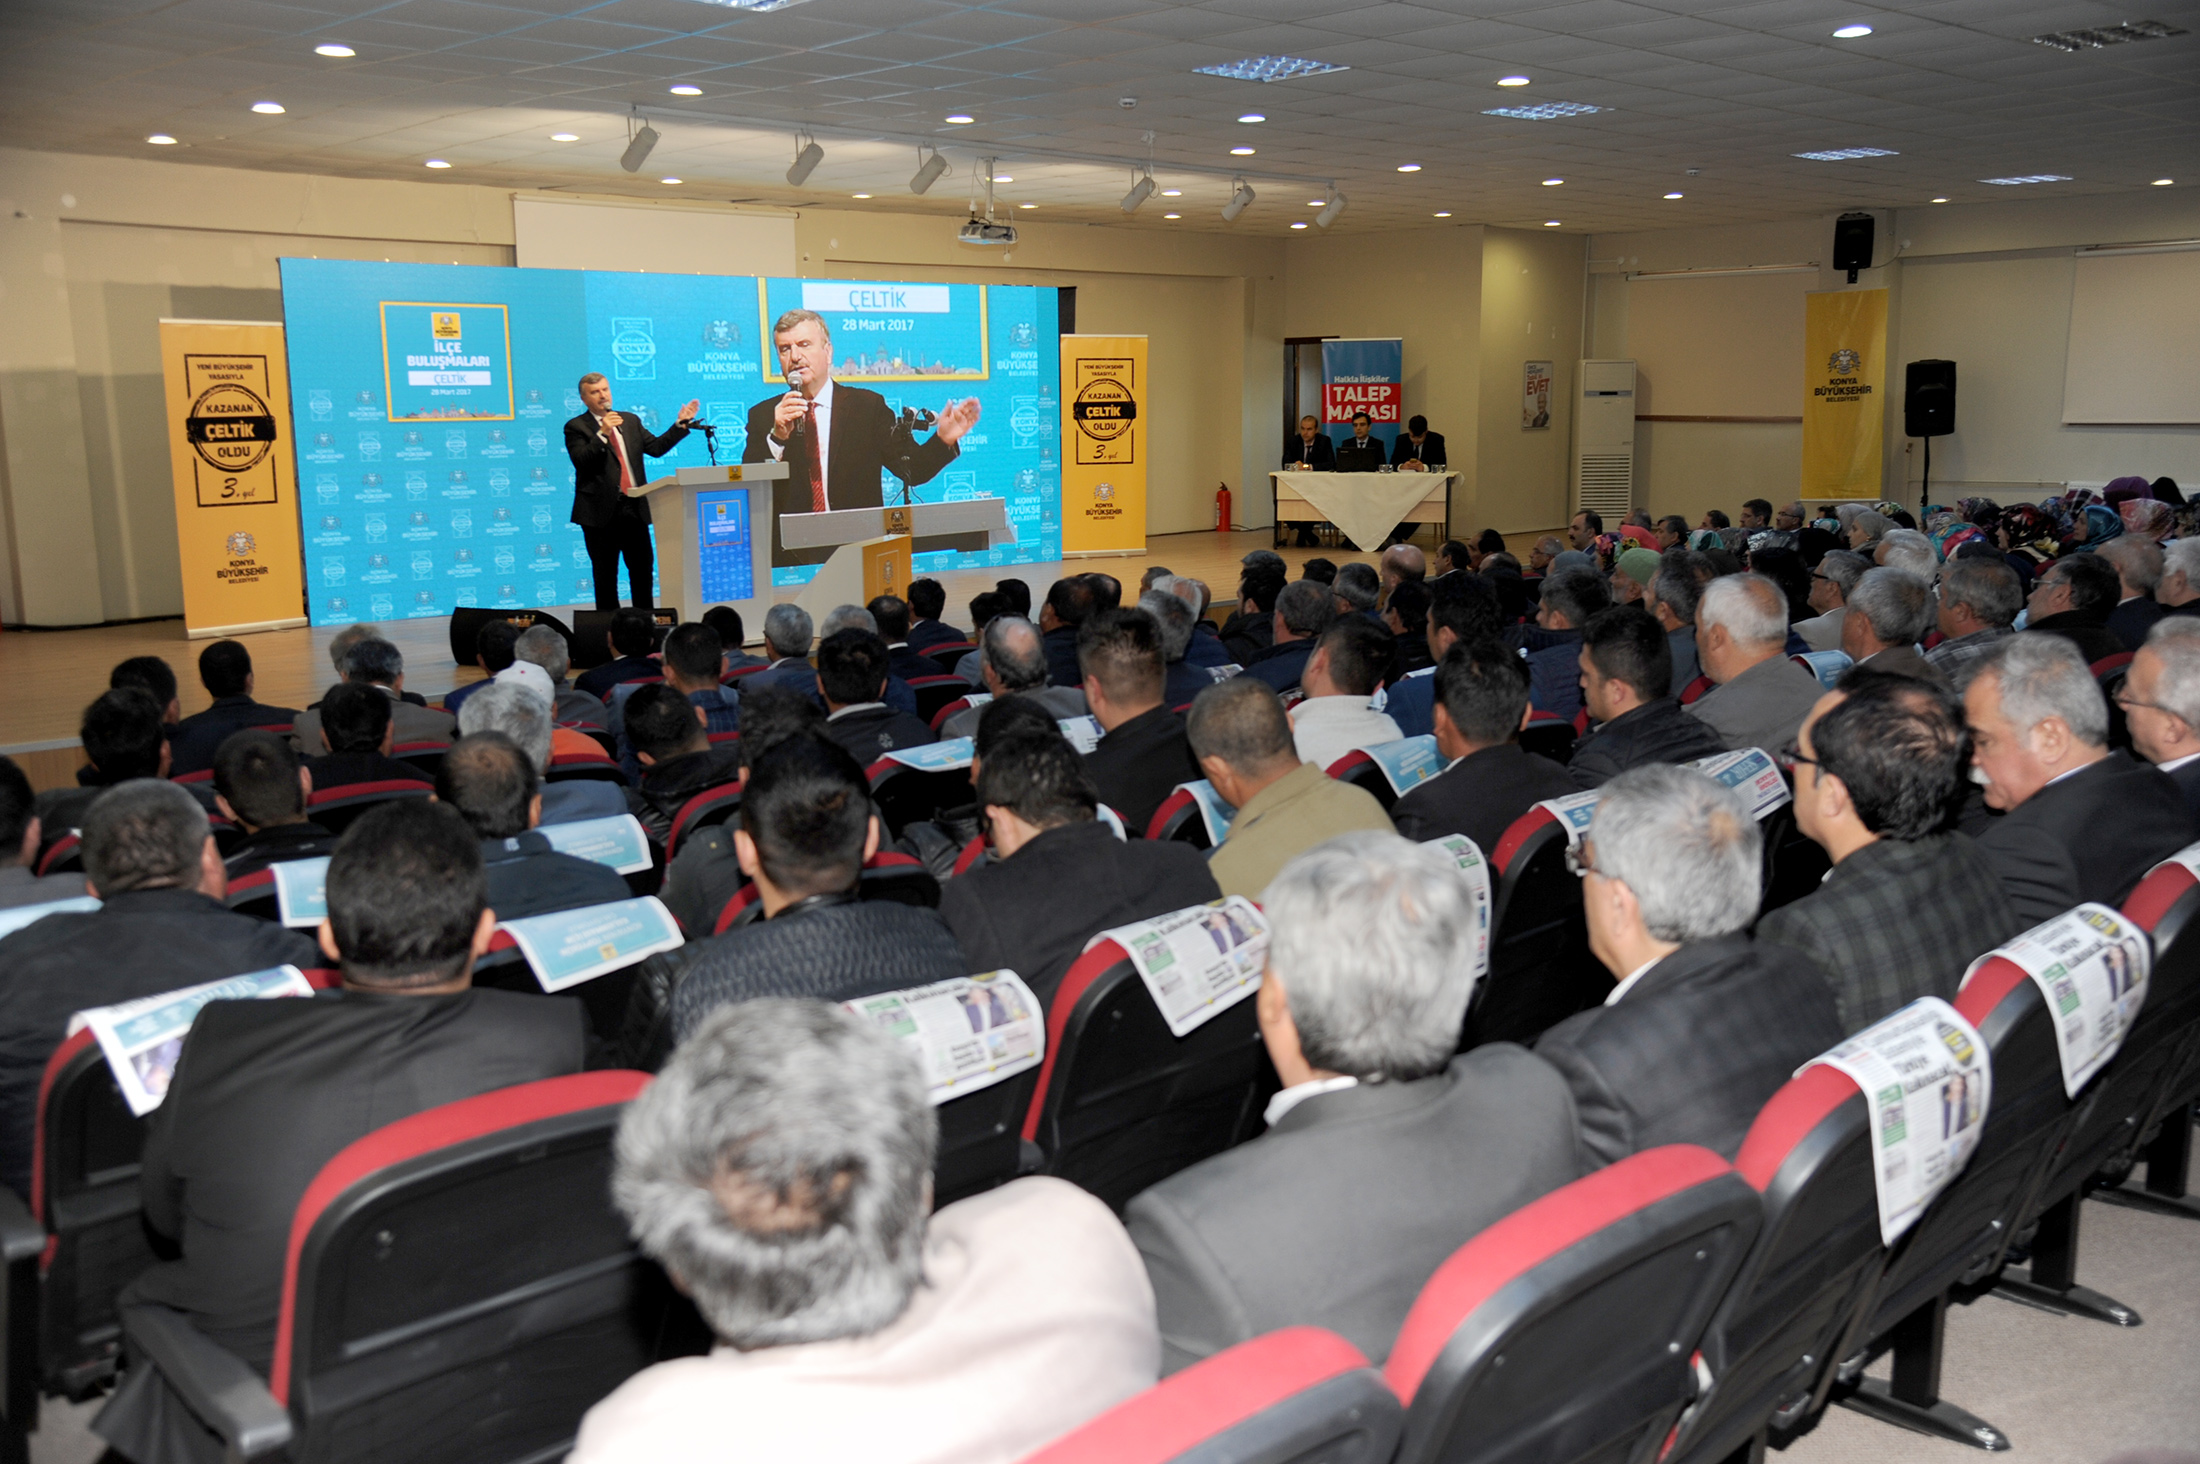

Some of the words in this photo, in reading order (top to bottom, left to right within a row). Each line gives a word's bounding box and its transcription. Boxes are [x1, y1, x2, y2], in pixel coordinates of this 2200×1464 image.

[849, 287, 907, 312] ÇELTİK
[842, 318, 857, 331] 28
[858, 319, 886, 331] Mart
[887, 319, 914, 331] 2017
[433, 339, 462, 356] İLÇE
[406, 355, 490, 370] BULUŞMALARI
[704, 352, 740, 361] KONYA
[213, 363, 254, 371] BÜYÜKŞEHİR
[687, 361, 758, 373] BÜYÜKŞEHİR
[433, 372, 467, 386] ÇELTİK
[1334, 375, 1359, 384] Halkla
[1359, 373, 1390, 384] İlişkiler
[1829, 378, 1857, 386] KONYA
[440, 388, 455, 396] Mart
[456, 388, 471, 396] 2017
[1526, 377, 1550, 396] EVET
[1814, 384, 1872, 397] BÜYÜKŞEHİR
[1333, 386, 1392, 402] TALEP
[1825, 395, 1860, 403] BELEDİYESİ
[206, 404, 254, 413] KAZANAN
[1086, 404, 1121, 419] ÇELTİK
[1327, 404, 1397, 421] MASASI
[205, 420, 256, 441] ÇELTİK
[1093, 422, 1117, 431] OLDU
[217, 446, 250, 458] OLDU
[1093, 444, 1107, 459] 3.
[221, 477, 240, 498] 3.
[1085, 508, 1122, 516] BÜYÜKŞEHİR
[229, 559, 256, 567] KONYA
[217, 566, 269, 579] BÜYÜKŞEHİR
